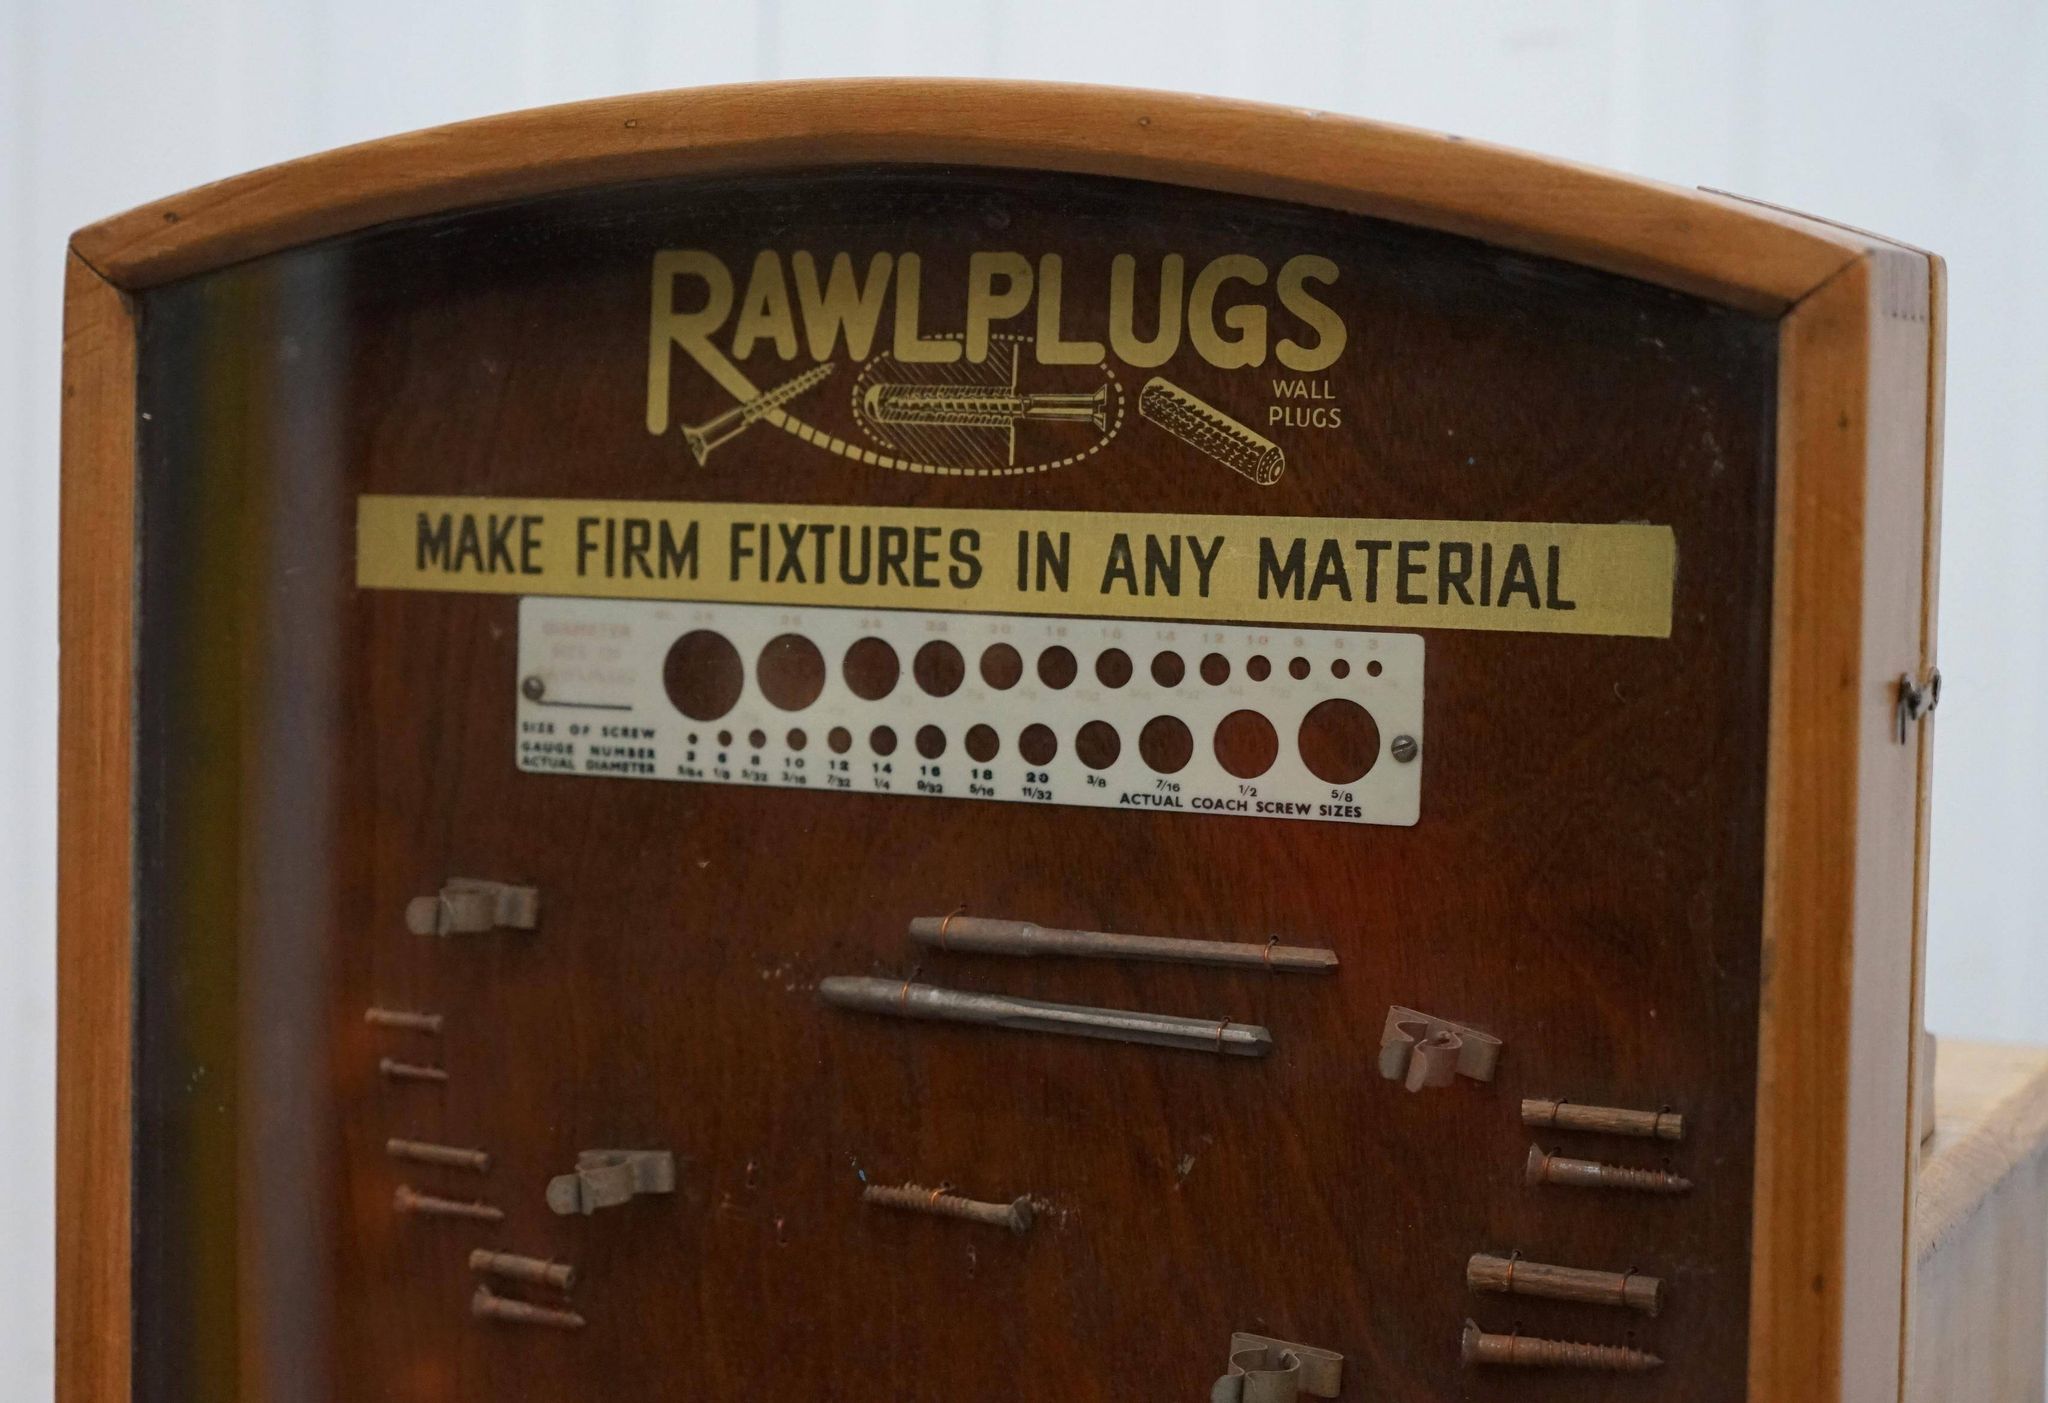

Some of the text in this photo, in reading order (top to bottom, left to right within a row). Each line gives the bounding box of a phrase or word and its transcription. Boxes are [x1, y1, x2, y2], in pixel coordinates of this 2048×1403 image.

[646, 249, 1348, 435] RAWLPLUGS
[1272, 379, 1336, 399] WALL
[1269, 405, 1342, 429] PLUGS
[416, 512, 1577, 611] MAKE FIRM FIXTURES IN ANY MATERIAL
[522, 721, 555, 735] SIZE
[601, 725, 656, 739] SCREW
[590, 744, 656, 760] NUMBER
[521, 755, 656, 774] ACTUAL DIAMETER
[872, 762, 892, 774] 14
[971, 768, 993, 781] 18
[969, 783, 995, 797] 5/16
[1021, 786, 1053, 801] 11/32
[1086, 774, 1107, 788] 3/8
[1155, 778, 1181, 793] 7/16
[1238, 784, 1257, 798] 1/2
[1330, 789, 1353, 803] 5/8
[1119, 792, 1362, 818] ACTUAL COACH SCREW SIZES
